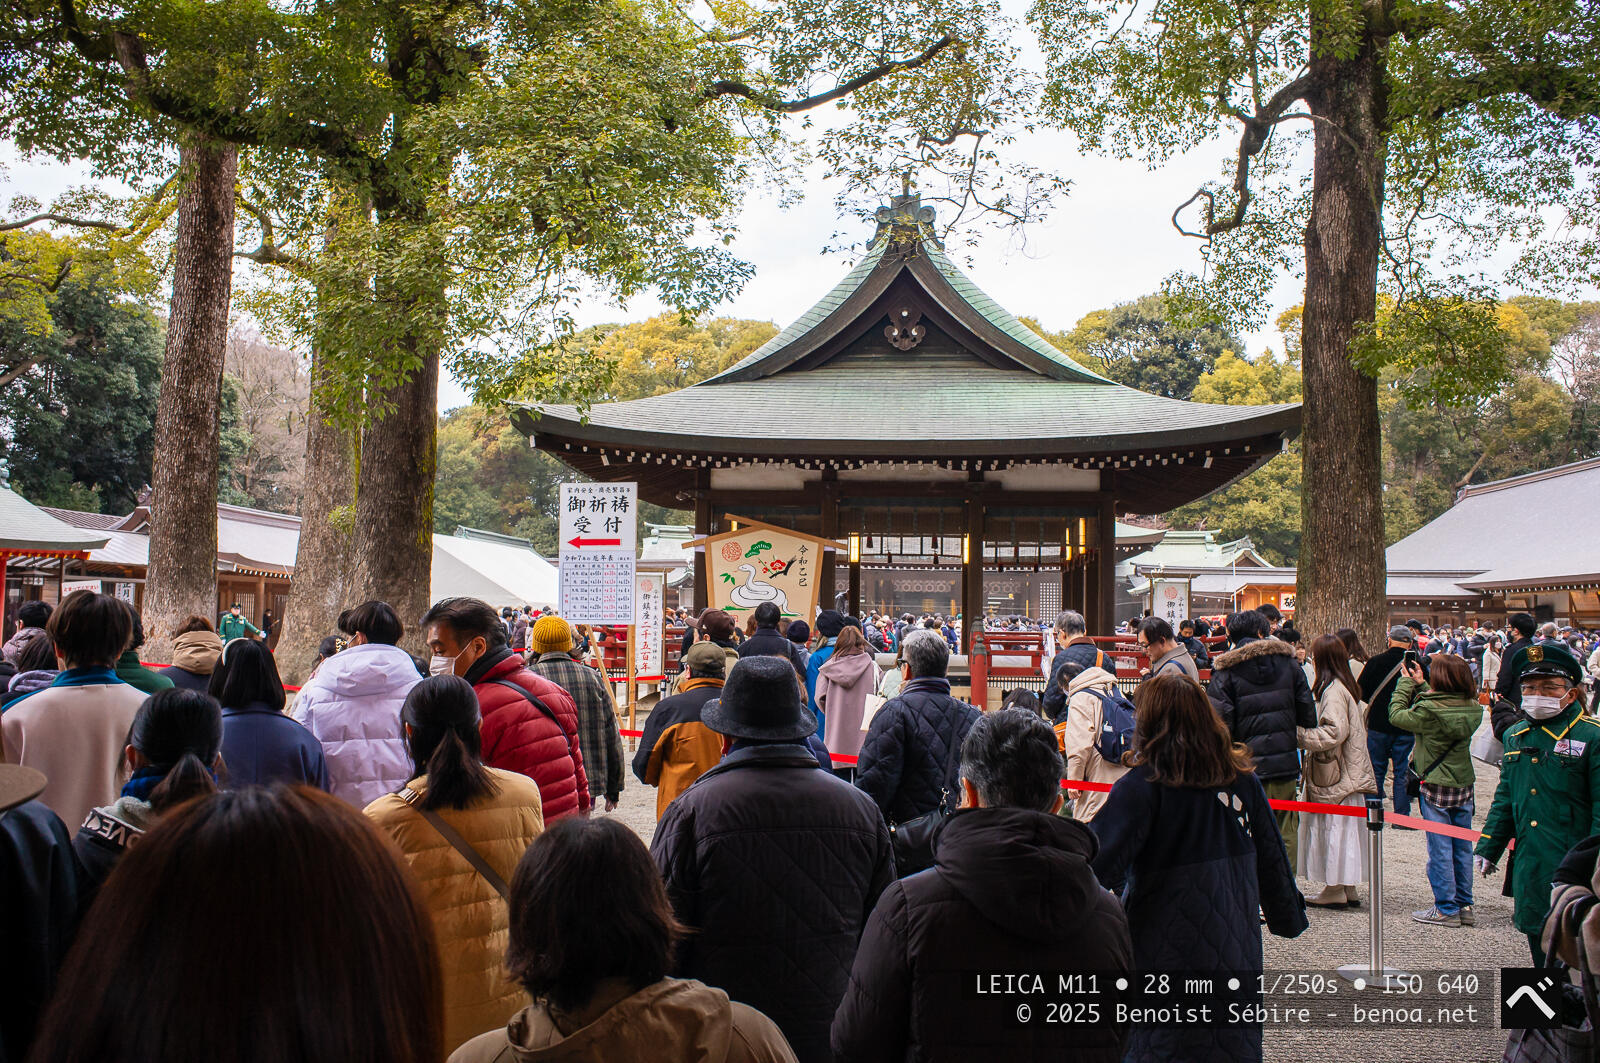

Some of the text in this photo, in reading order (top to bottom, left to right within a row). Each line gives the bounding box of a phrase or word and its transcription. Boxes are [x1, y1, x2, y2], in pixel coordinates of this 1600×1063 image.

[567, 495, 630, 513] 御祈祷
[573, 515, 623, 534] 受付
[798, 544, 809, 587] 令和乙巳
